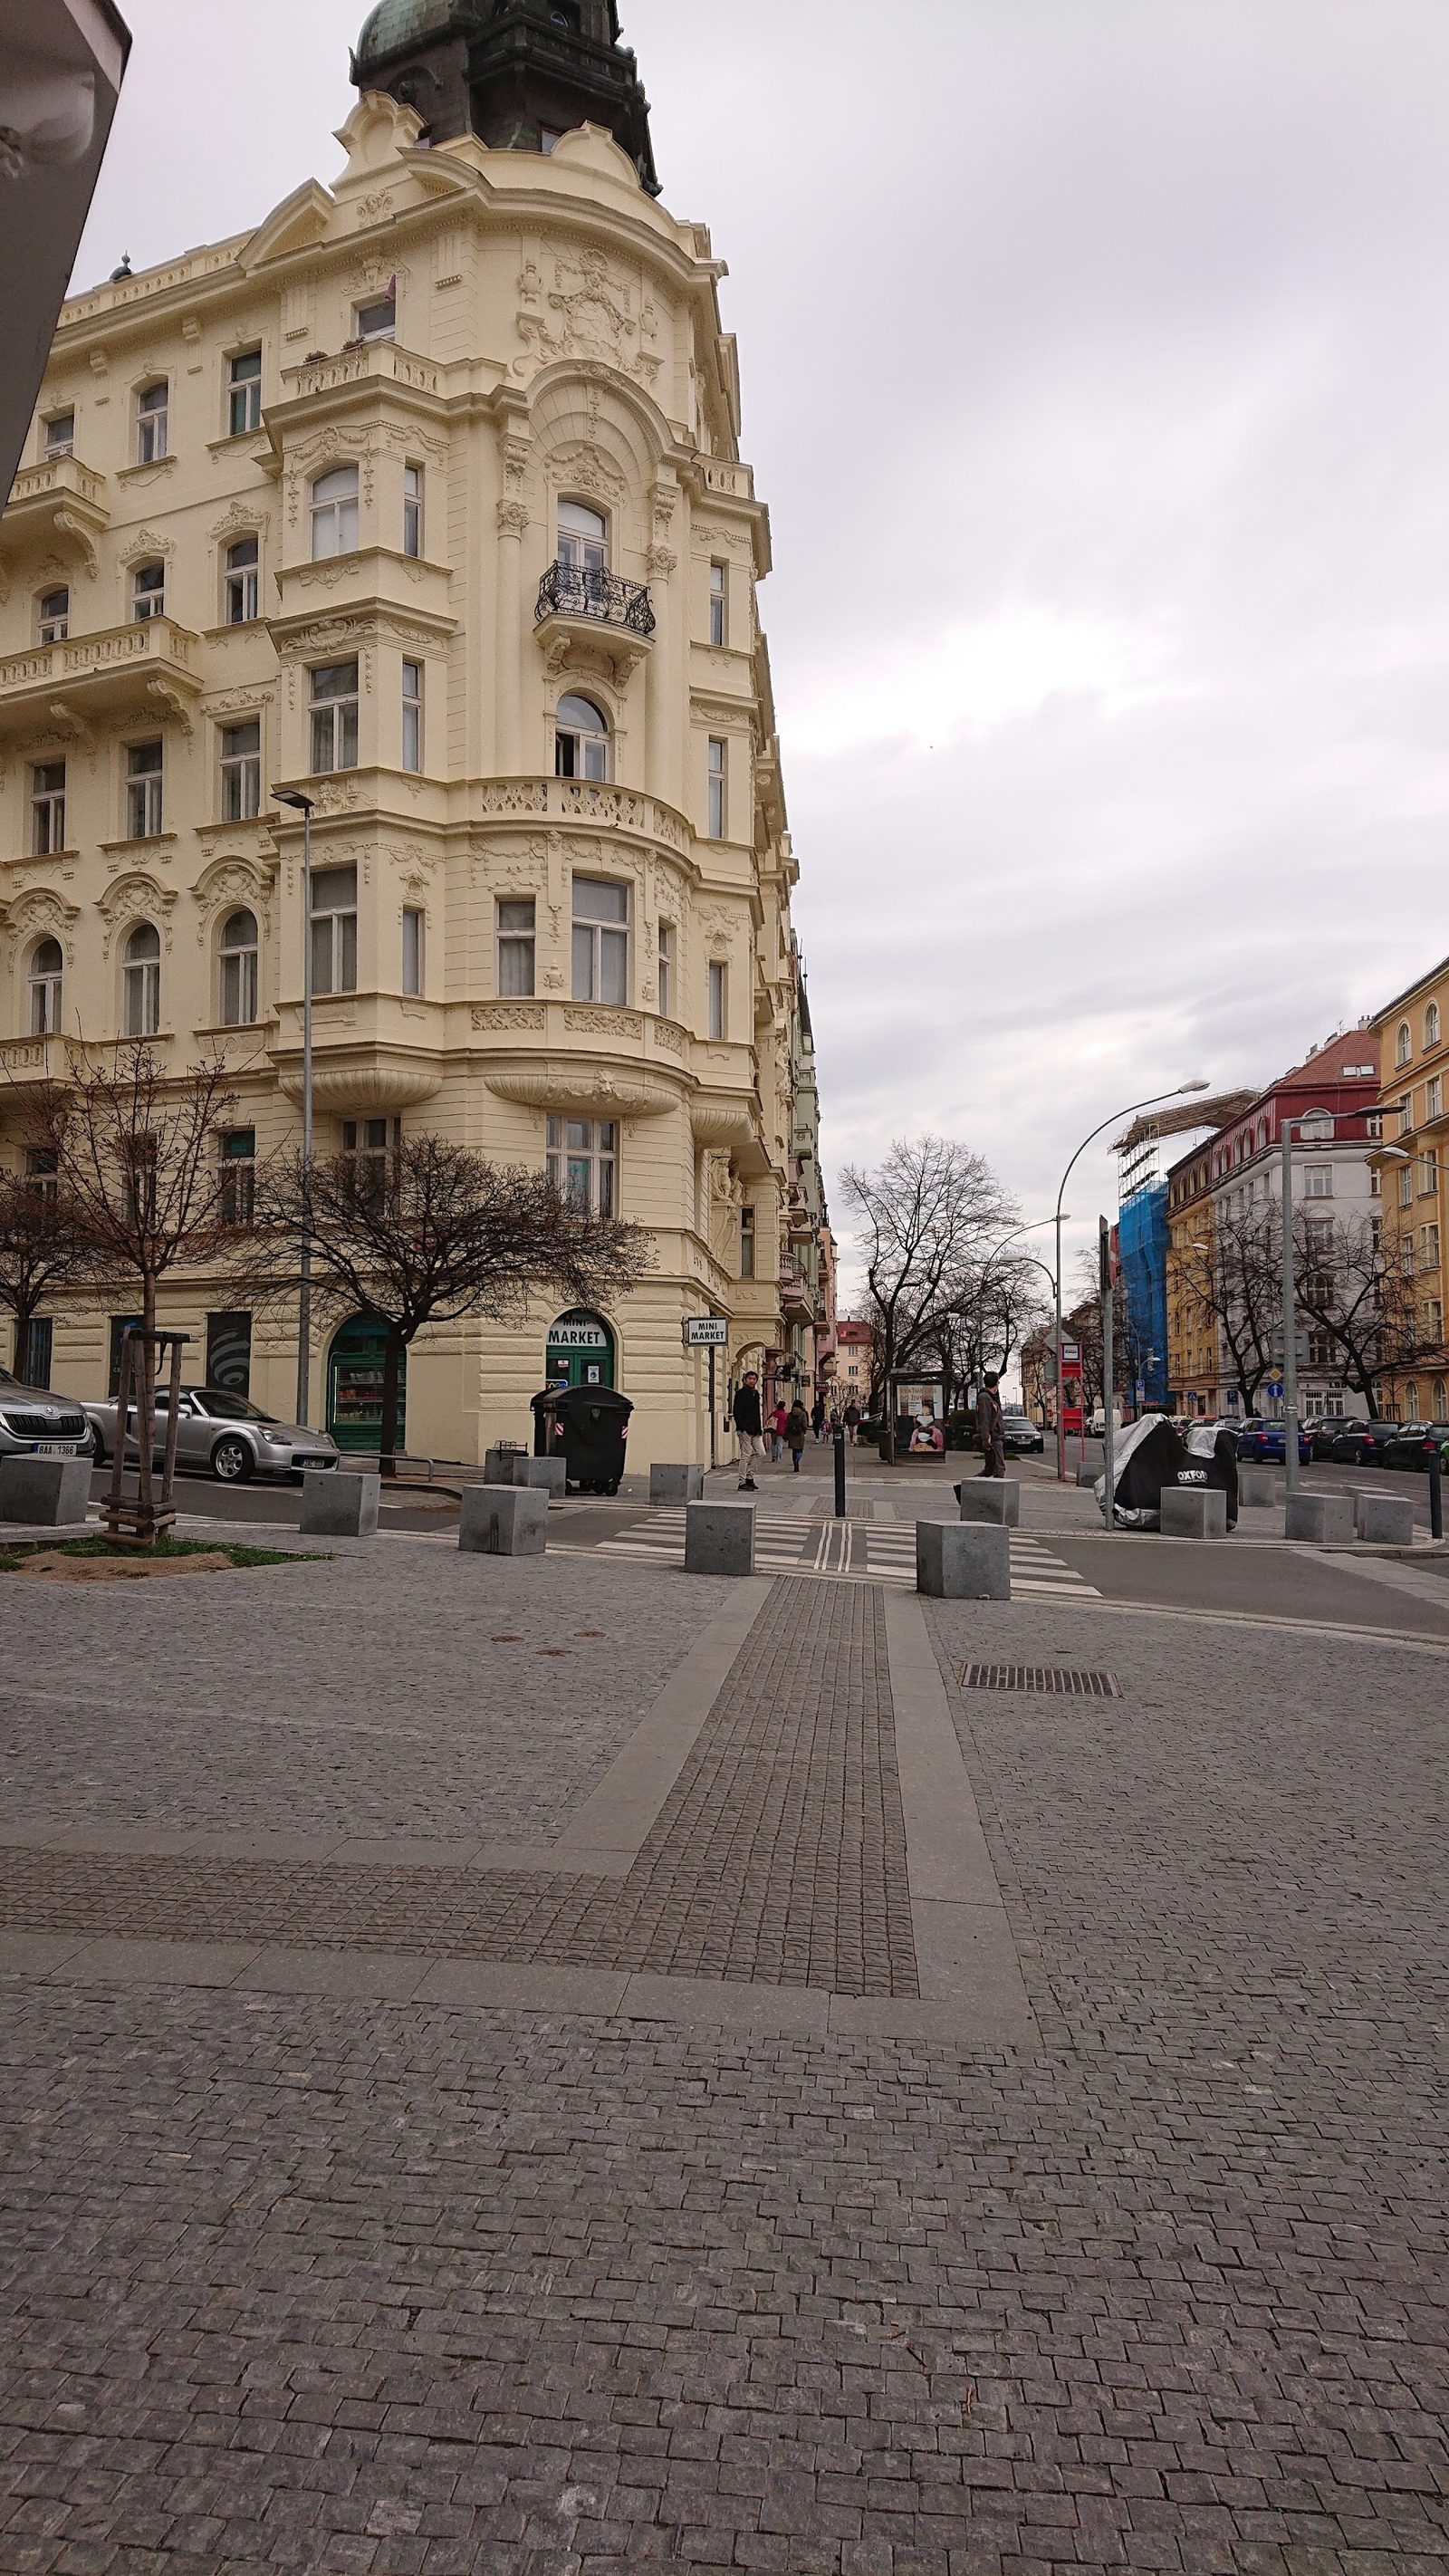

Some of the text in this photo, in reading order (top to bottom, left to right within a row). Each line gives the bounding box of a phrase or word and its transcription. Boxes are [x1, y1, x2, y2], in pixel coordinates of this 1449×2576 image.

[563, 1318, 586, 1327] MINI
[548, 1330, 600, 1344] MARKET
[691, 1331, 724, 1340] MARKET
[39, 1445, 74, 1455] 8AA 1366
[1177, 1470, 1208, 1481] OXFOD
